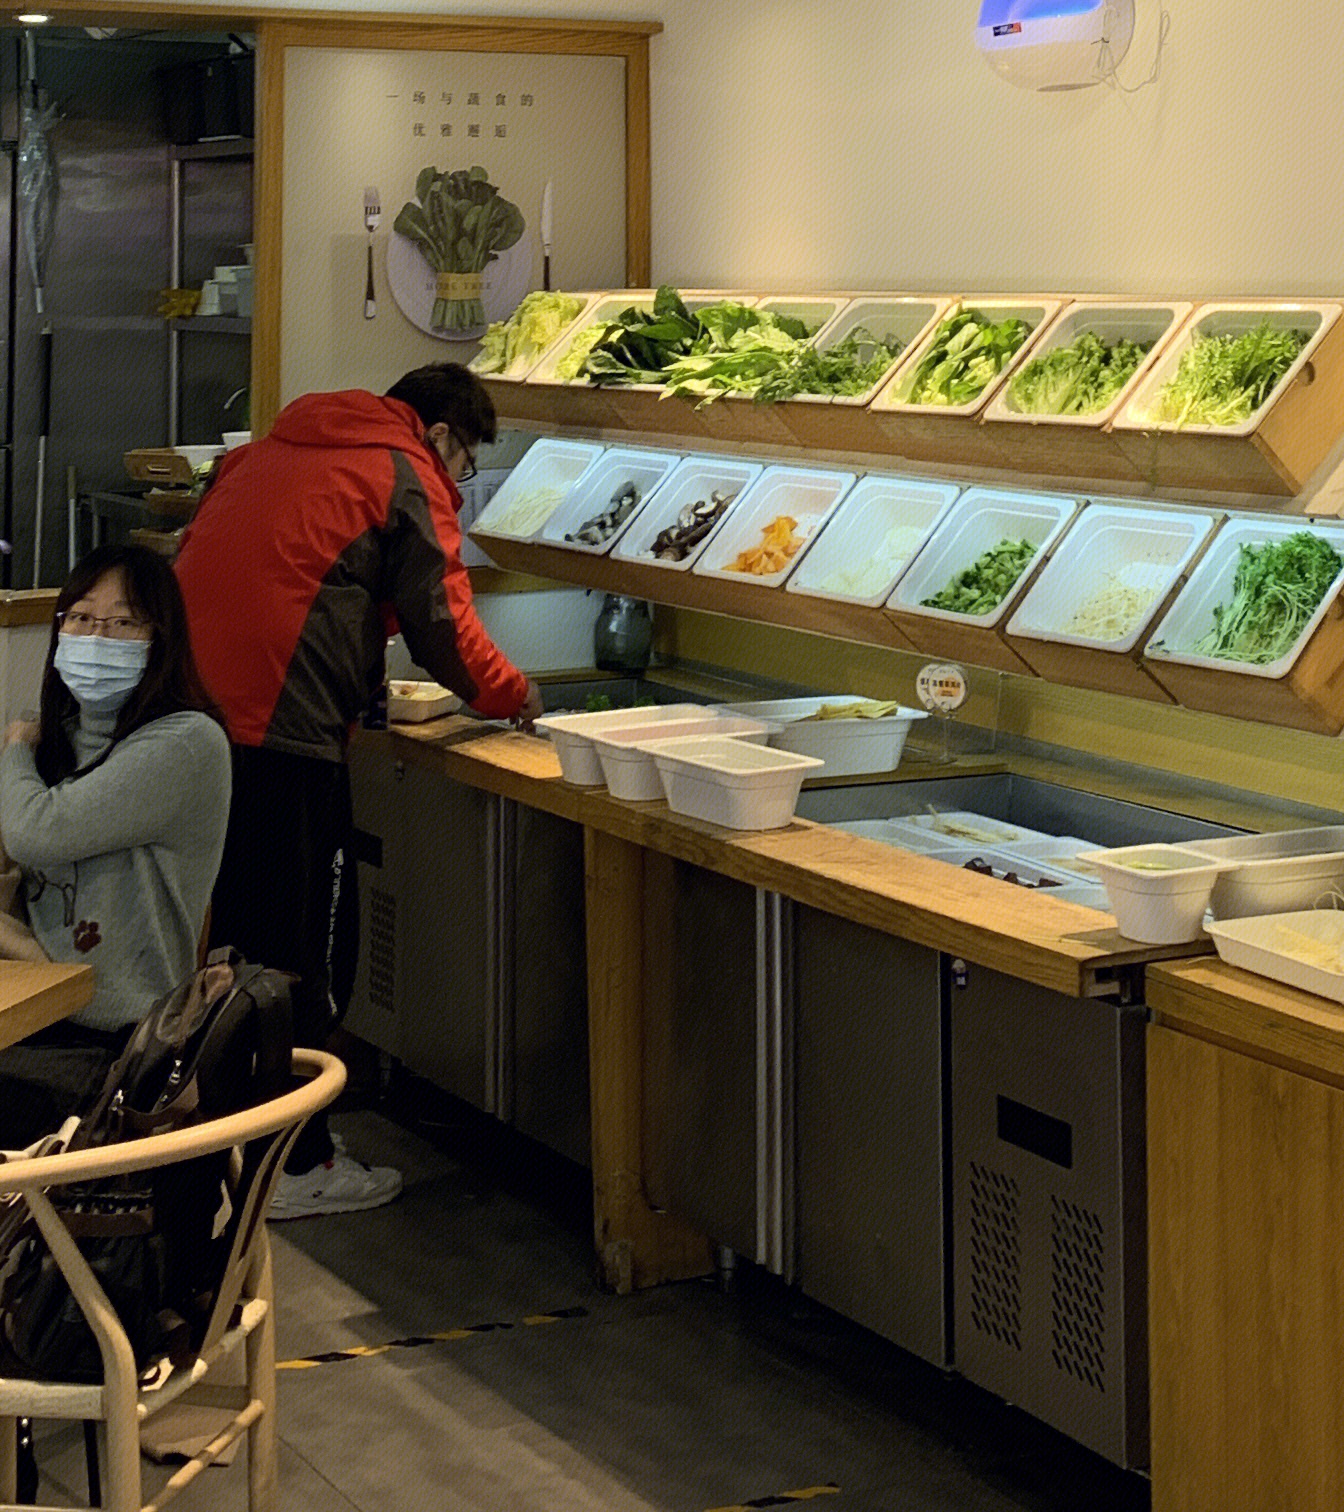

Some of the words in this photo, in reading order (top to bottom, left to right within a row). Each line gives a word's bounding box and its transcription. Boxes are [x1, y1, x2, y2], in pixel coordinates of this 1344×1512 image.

[386, 90, 534, 107] 一场与蔬食的
